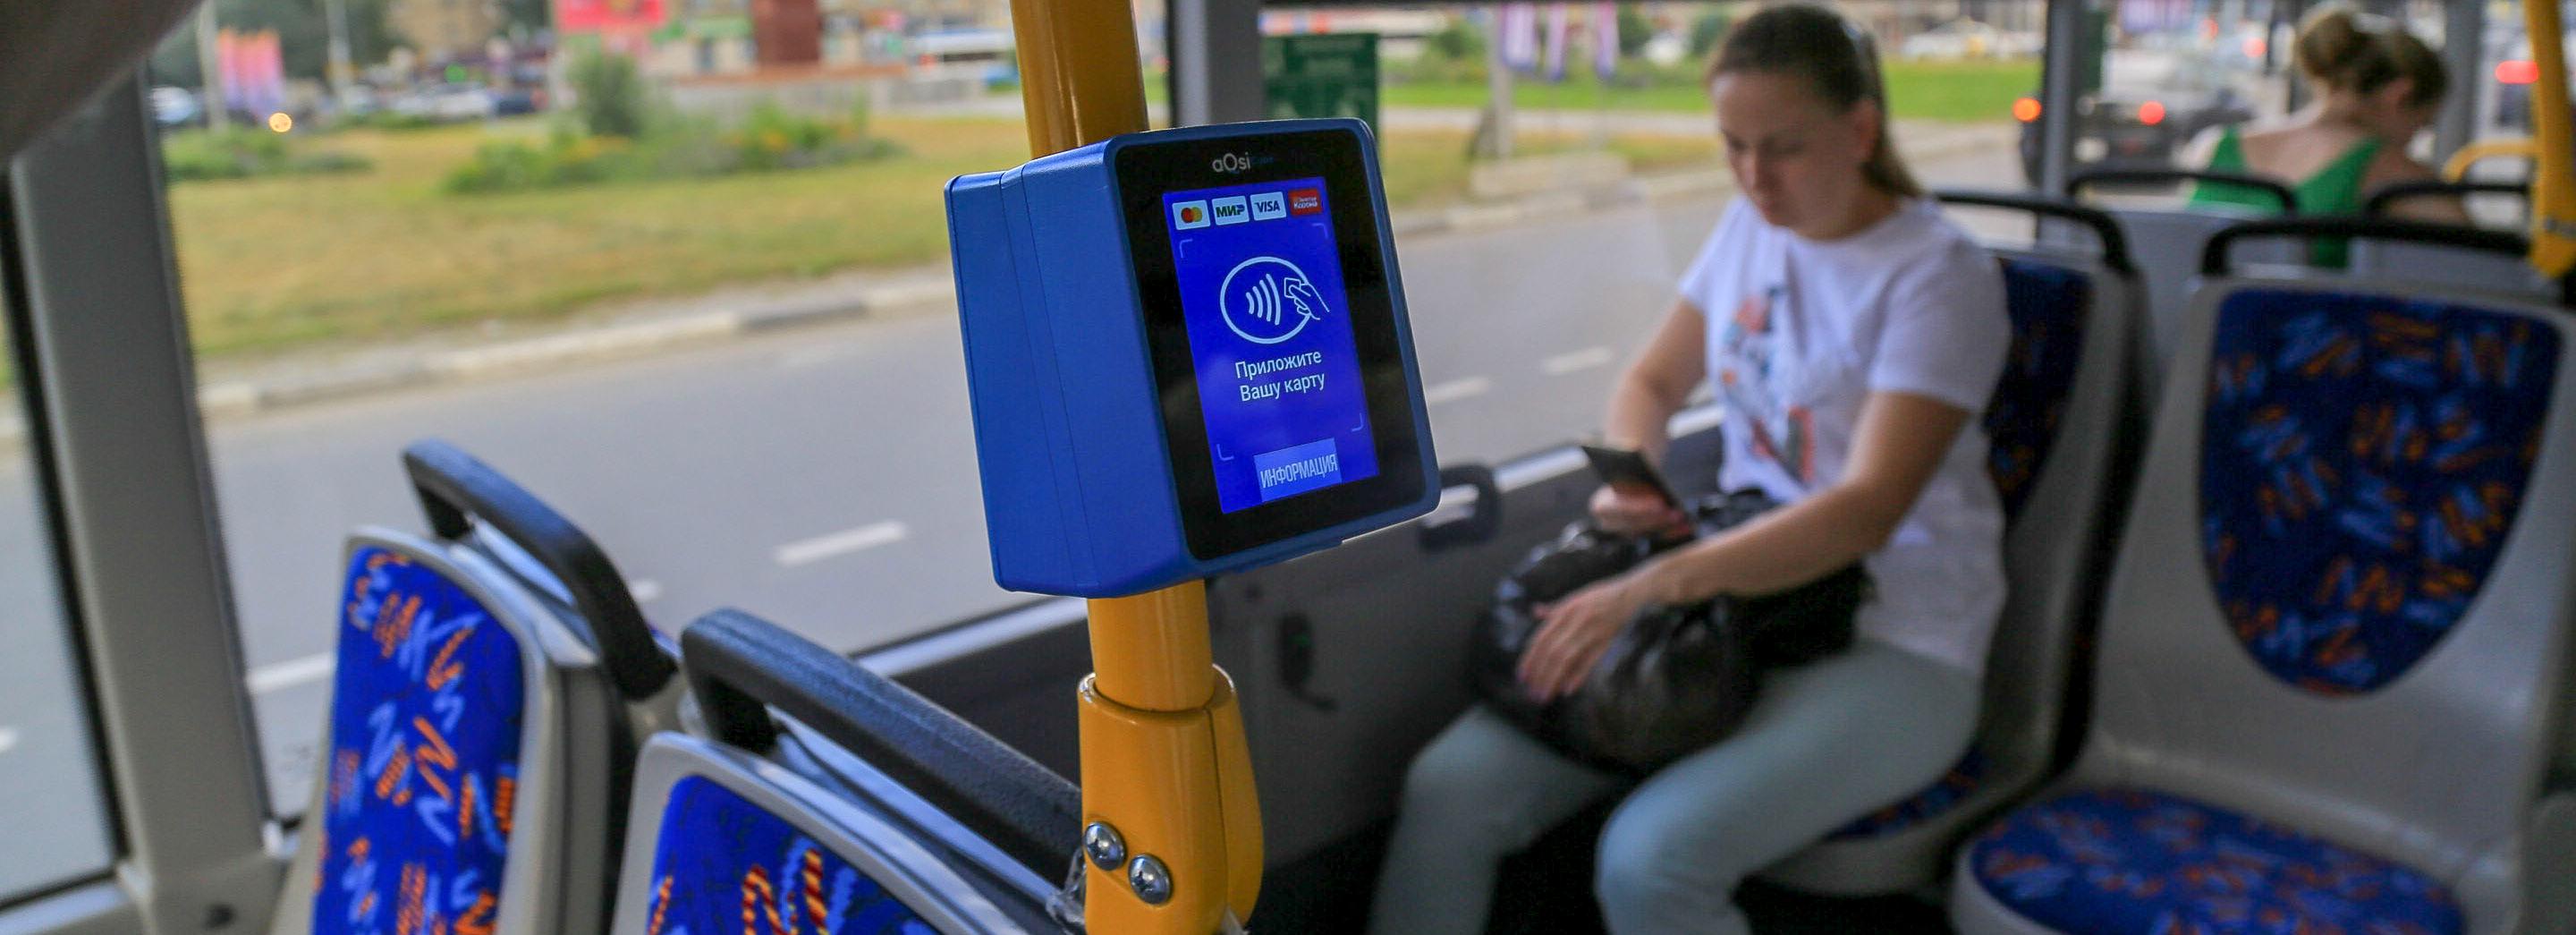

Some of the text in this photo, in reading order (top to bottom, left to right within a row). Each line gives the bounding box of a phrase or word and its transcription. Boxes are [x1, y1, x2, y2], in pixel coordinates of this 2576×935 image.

[1216, 204, 1245, 217] МИР
[1254, 200, 1280, 213] VISA
[1235, 351, 1322, 380] Приложите
[1240, 373, 1325, 402] Вашу карту
[1259, 454, 1338, 489] ИНФОРМАЦИЯ
